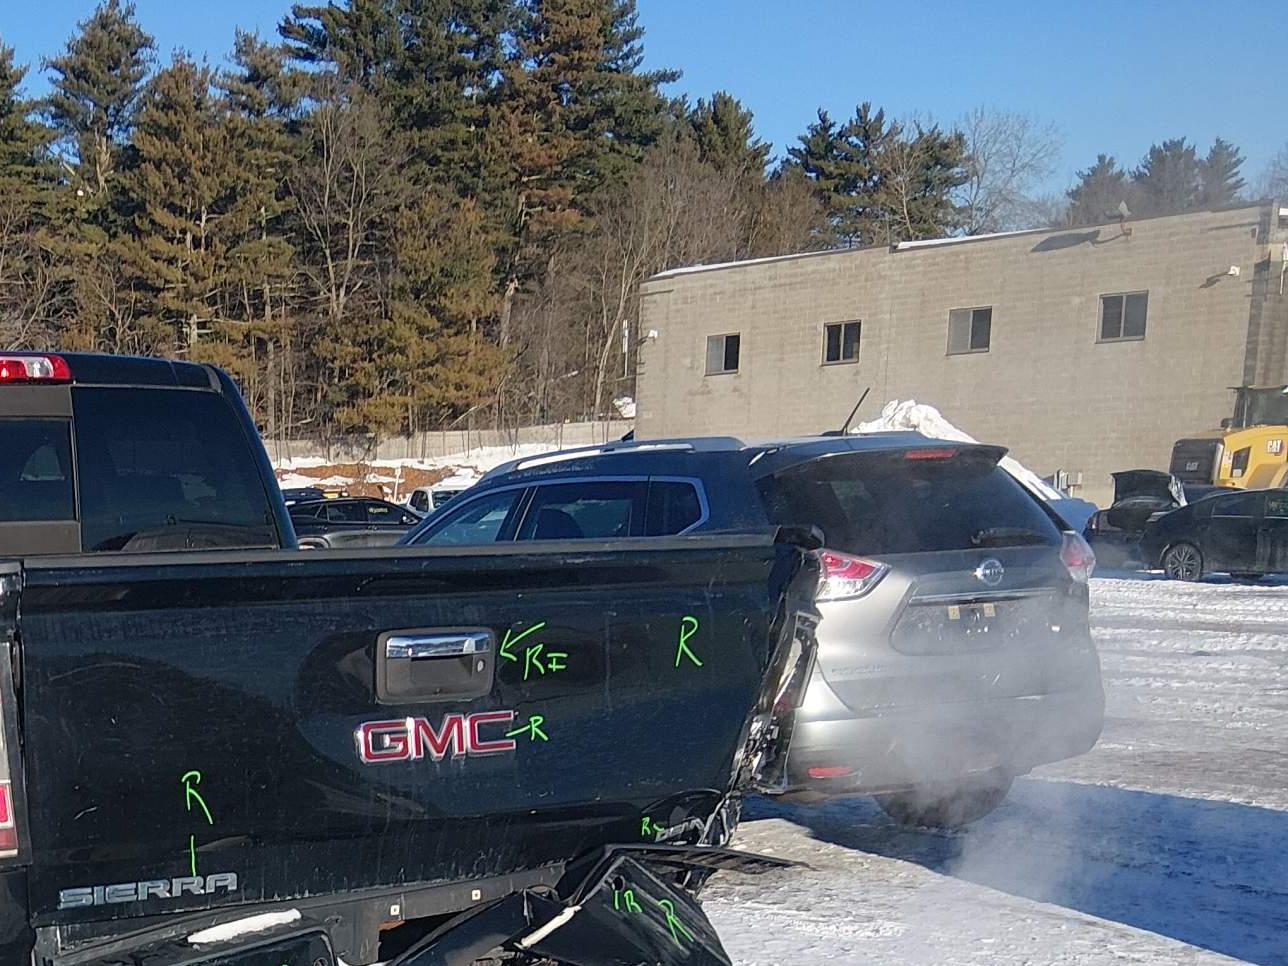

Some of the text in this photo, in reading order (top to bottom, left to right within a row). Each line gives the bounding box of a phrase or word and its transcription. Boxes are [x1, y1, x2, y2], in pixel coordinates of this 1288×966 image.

[1266, 439, 1282, 453] CAT
[675, 615, 703, 668] R
[354, 709, 516, 764] GMC
[528, 715, 549, 742] R
[181, 769, 214, 825] R
[56, 872, 239, 910] SIERRA
